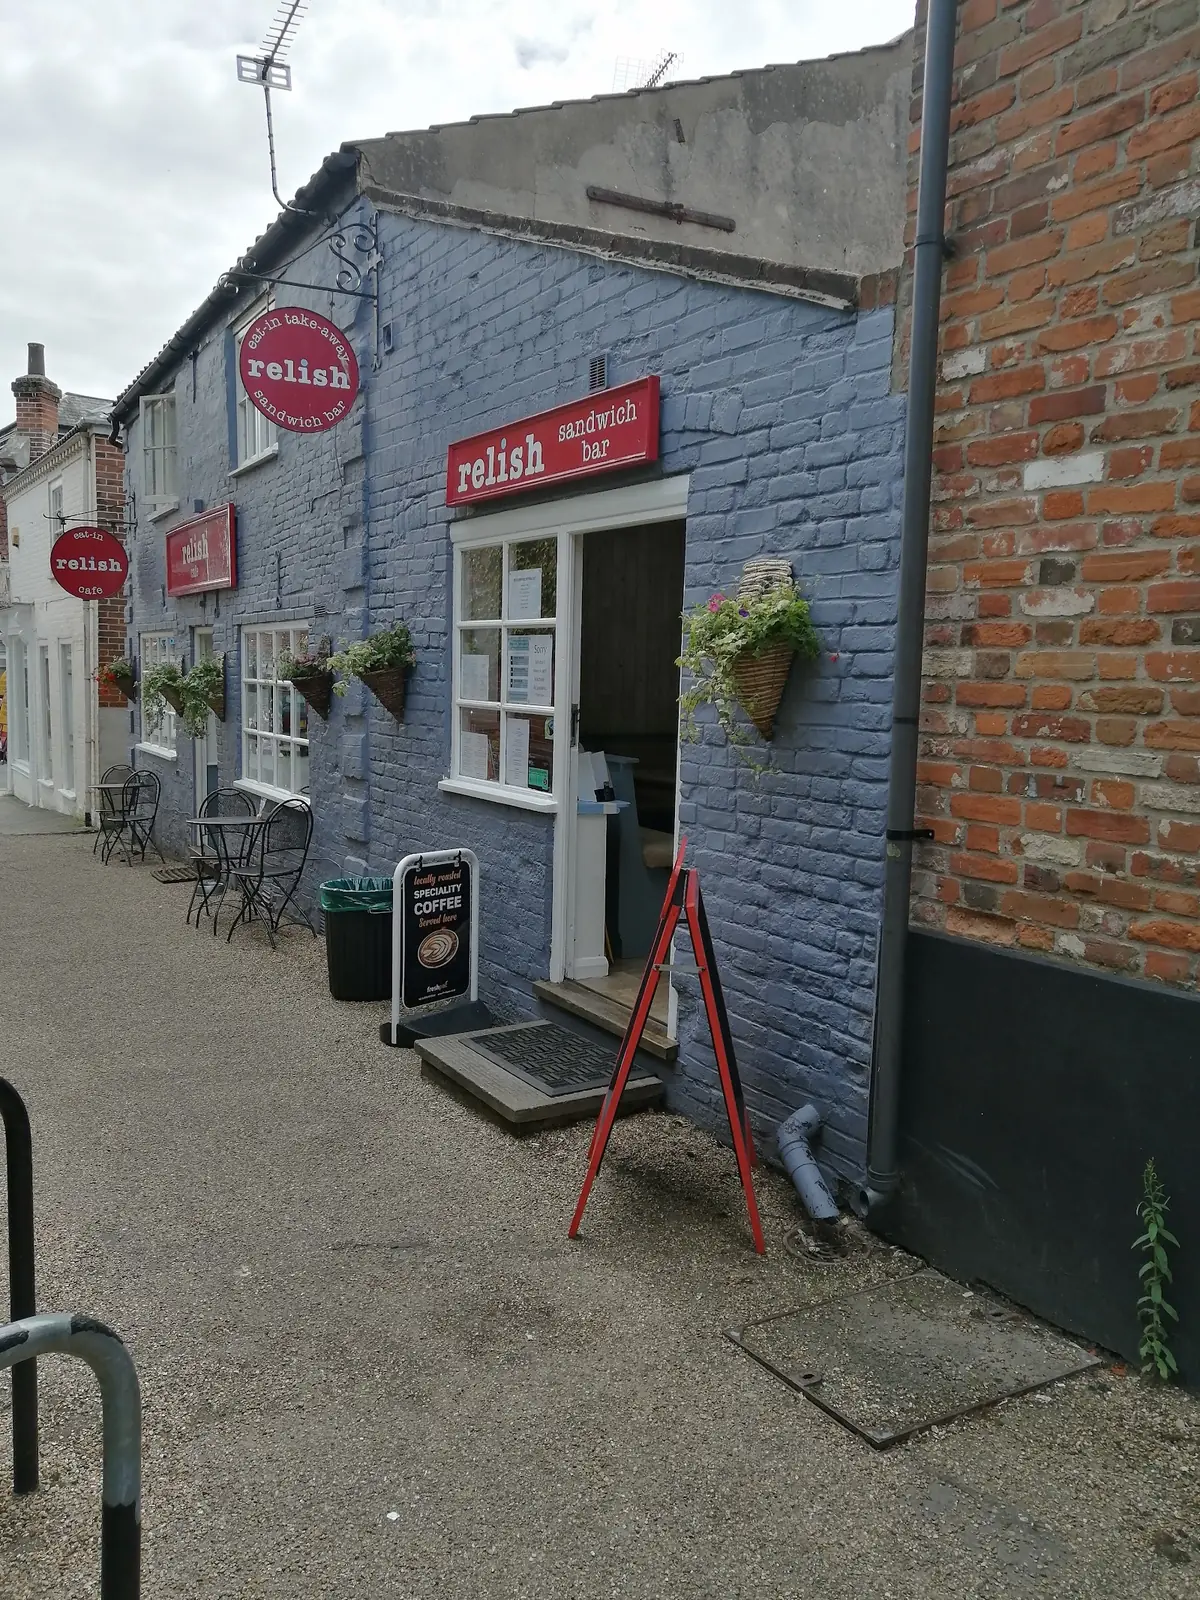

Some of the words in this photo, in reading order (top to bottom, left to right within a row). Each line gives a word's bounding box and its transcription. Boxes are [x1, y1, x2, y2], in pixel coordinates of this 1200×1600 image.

[248, 317, 283, 350] eat-in
[284, 313, 351, 363] take-away
[248, 358, 351, 389] relish
[254, 389, 323, 428] sandwich
[323, 400, 346, 422] bar
[558, 399, 637, 442] sandwich
[582, 438, 610, 462] bar
[457, 433, 544, 493] relish
[73, 530, 104, 542] eat-in
[182, 531, 209, 565] relish
[56, 556, 122, 572] relish
[78, 586, 103, 595] cafe
[414, 874, 436, 886] locally
[438, 870, 462, 882] roasted
[414, 884, 462, 898] SPECIALITY
[414, 896, 462, 915] COFFEE
[418, 916, 441, 928] Served
[443, 914, 458, 924] here
